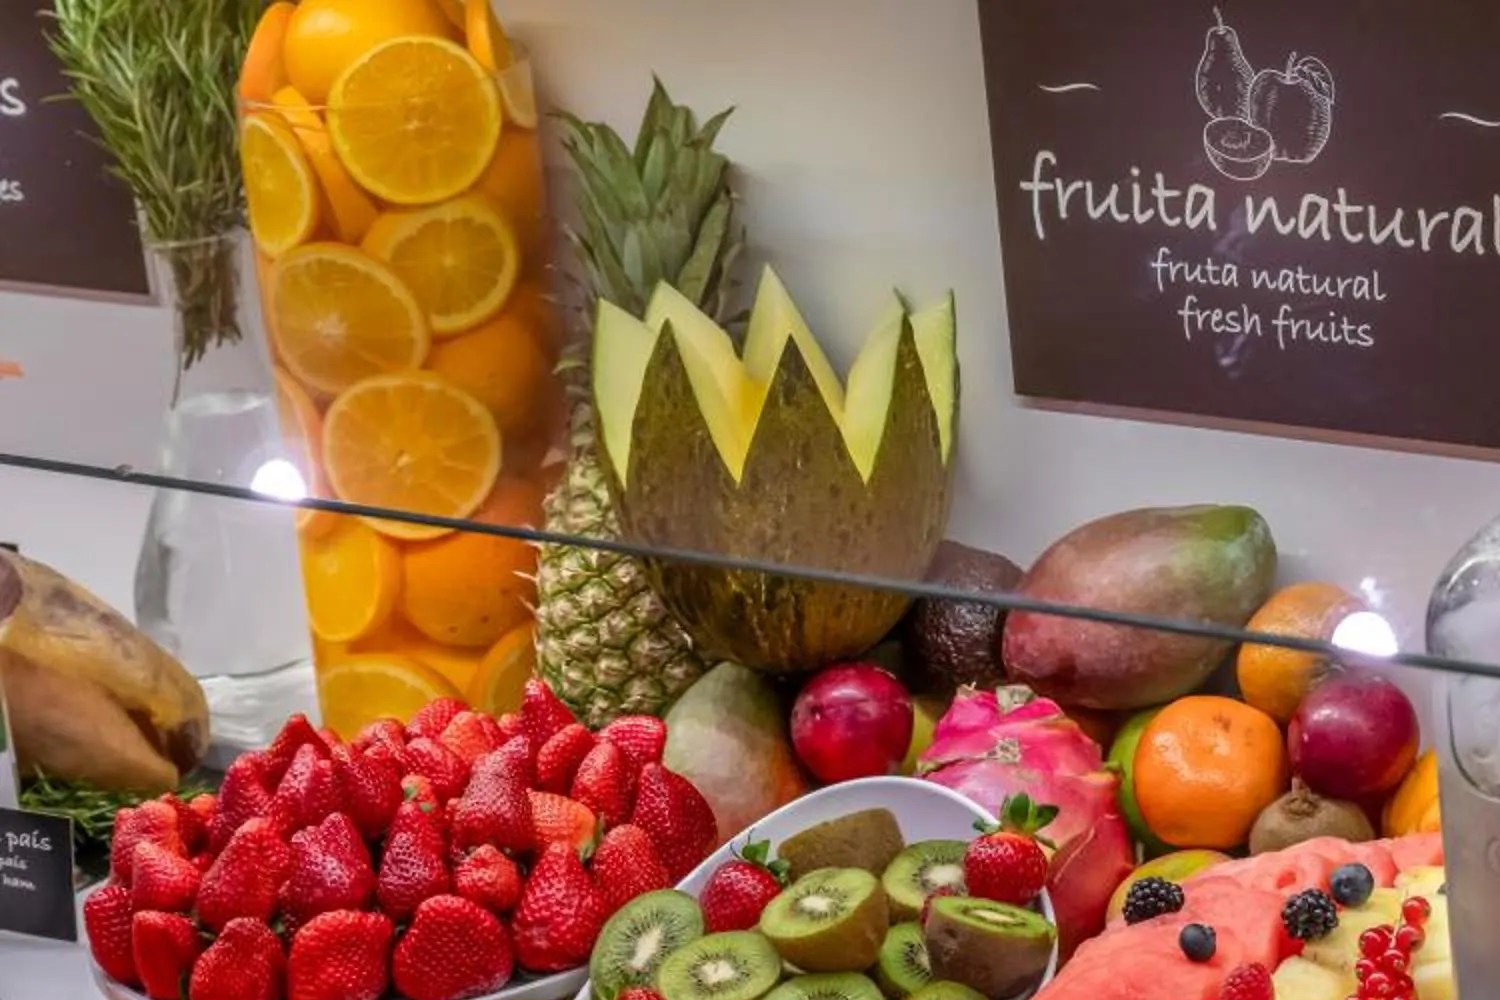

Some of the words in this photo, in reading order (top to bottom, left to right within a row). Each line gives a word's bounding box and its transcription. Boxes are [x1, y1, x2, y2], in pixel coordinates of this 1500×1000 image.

[1020, 150, 1216, 240] fruita
[1151, 248, 1238, 291] fruta
[1251, 266, 1386, 301] natural
[1178, 296, 1262, 339] fresh
[1272, 306, 1375, 349] fruits
